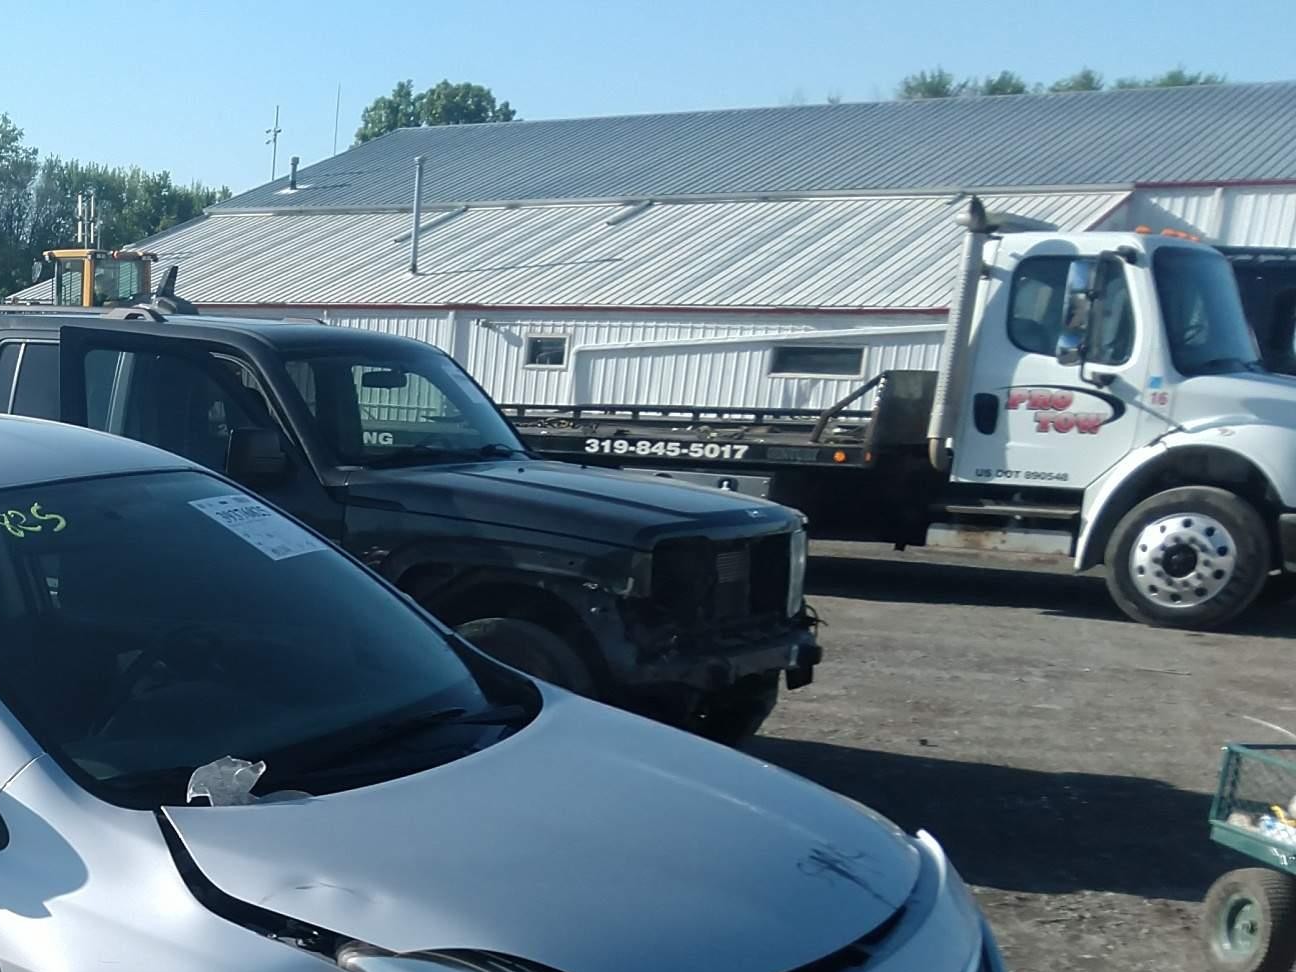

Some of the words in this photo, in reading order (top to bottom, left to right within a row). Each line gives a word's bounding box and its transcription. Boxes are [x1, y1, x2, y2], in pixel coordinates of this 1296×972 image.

[1006, 388, 1074, 411] PRO
[1033, 411, 1108, 435] TOW
[584, 438, 749, 460] 319-845-5017
[975, 468, 992, 478] US
[995, 469, 1021, 479] DOT
